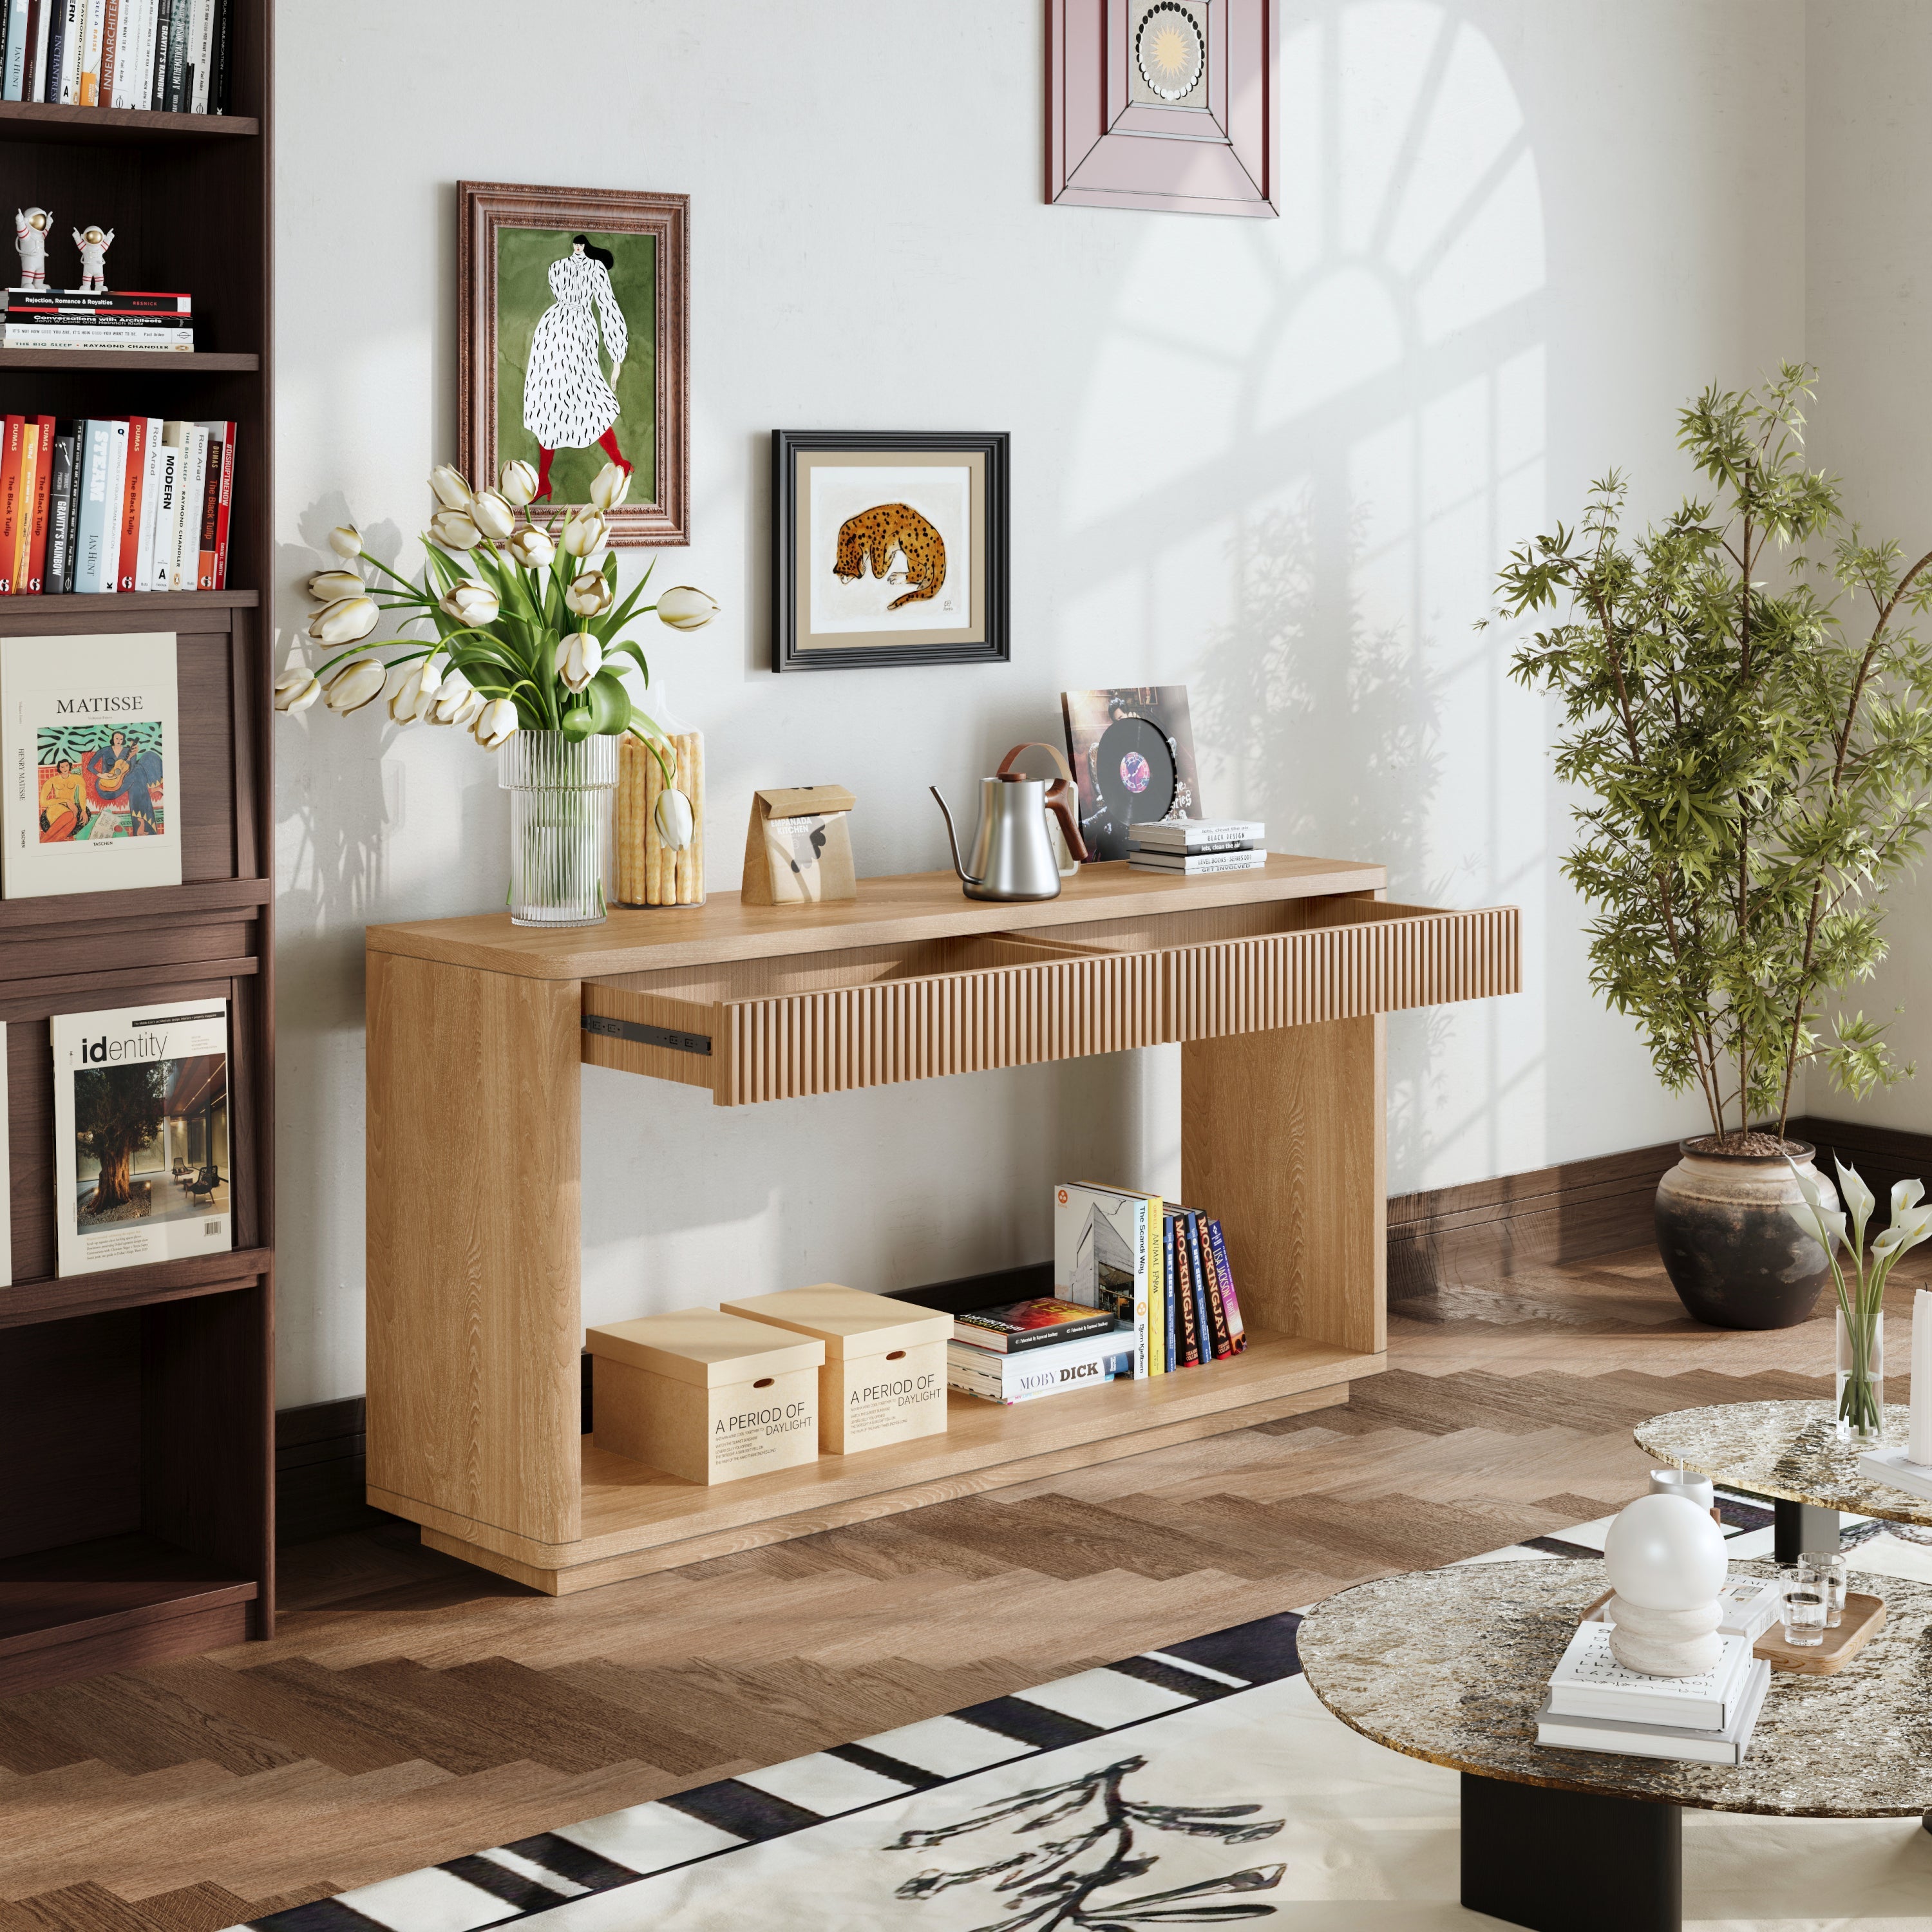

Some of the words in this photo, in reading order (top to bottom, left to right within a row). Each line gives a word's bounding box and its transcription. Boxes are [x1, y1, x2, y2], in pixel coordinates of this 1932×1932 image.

[160, 26, 168, 62] GRAVITY'S
[176, 21, 184, 42] MOSAIC
[12, 64, 21, 90] HUNT
[51, 35, 62, 101] ENCHANTRESS
[173, 43, 183, 84] MATHEMATICAL
[157, 64, 166, 99] RAINBOW
[90, 431, 108, 502] STEAM
[164, 455, 175, 510] MODERN
[208, 480, 217, 495] The
[55, 501, 66, 538] GRAVITY'S
[206, 497, 216, 518] Black
[89, 535, 98, 549] IAN
[205, 522, 215, 540] Tulip
[52, 540, 63, 576] RAINBOW
[87, 552, 97, 576] HUNT
[57, 696, 143, 714] MATISSE
[770, 817, 812, 828] EMPANADA
[777, 825, 809, 835] KITCHEN
[82, 1031, 167, 1063] identity
[1213, 1247, 1222, 1265] LISA
[1175, 1220, 1195, 1346] MOCKINGJAY
[1194, 1263, 1202, 1292] SEEN
[1197, 1216, 1226, 1339] MOCKINGJAY
[1216, 1267, 1231, 1298] JACKSON
[1031, 1302, 1079, 1314] 451
[1226, 1298, 1235, 1314] LIGHT
[960, 1314, 1025, 1331] BRADBURY
[851, 1391, 860, 1405] A
[864, 1379, 913, 1402] PERIOD
[917, 1374, 934, 1389] OF
[1020, 1372, 1056, 1390] MOBY
[1059, 1362, 1099, 1381] DICK
[898, 1388, 942, 1406] DAYLIGHT
[715, 1419, 725, 1434] A
[730, 1408, 781, 1431] PERIOD
[786, 1401, 804, 1418] OF
[766, 1417, 812, 1435] DAYLIGHT
